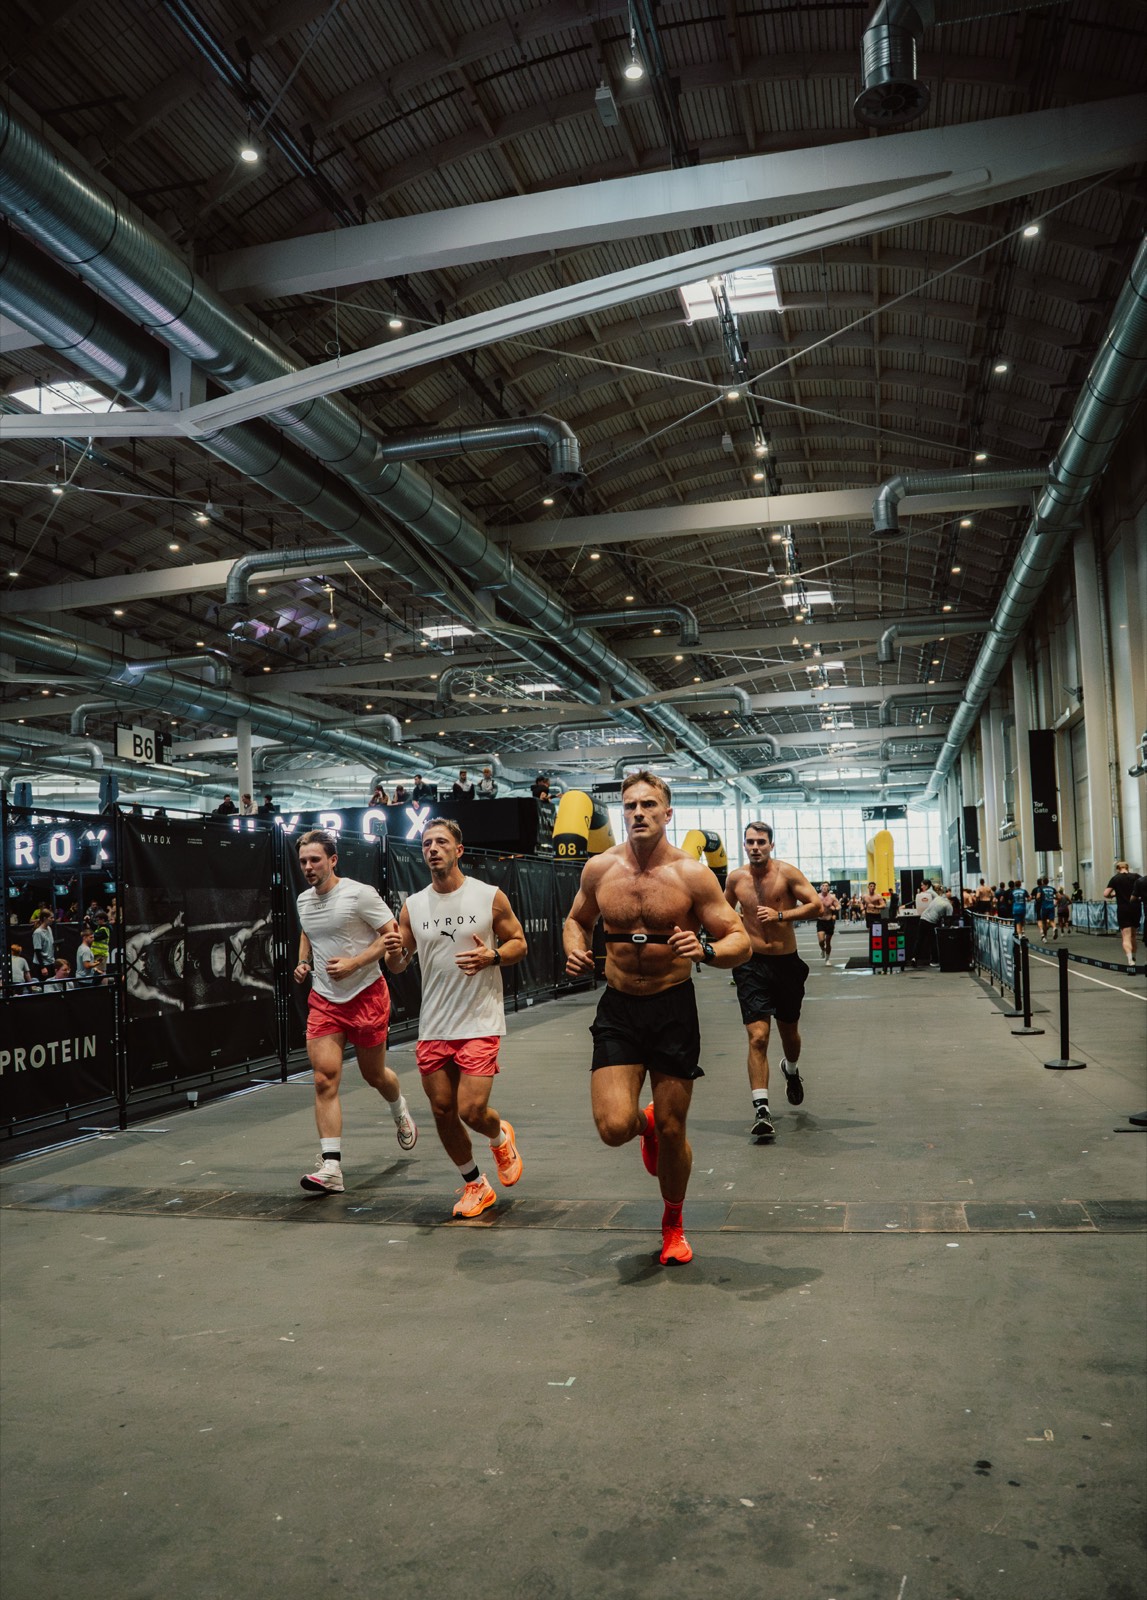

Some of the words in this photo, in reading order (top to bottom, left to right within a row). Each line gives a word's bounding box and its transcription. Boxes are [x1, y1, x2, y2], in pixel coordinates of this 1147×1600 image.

[133, 733, 153, 760] B6
[862, 810, 875, 819] B7
[1051, 814, 1058, 822] 9
[140, 833, 171, 845] HYROX
[558, 842, 577, 856] 08
[422, 915, 477, 930] HYROX
[0, 1035, 96, 1076] PROTEIN
